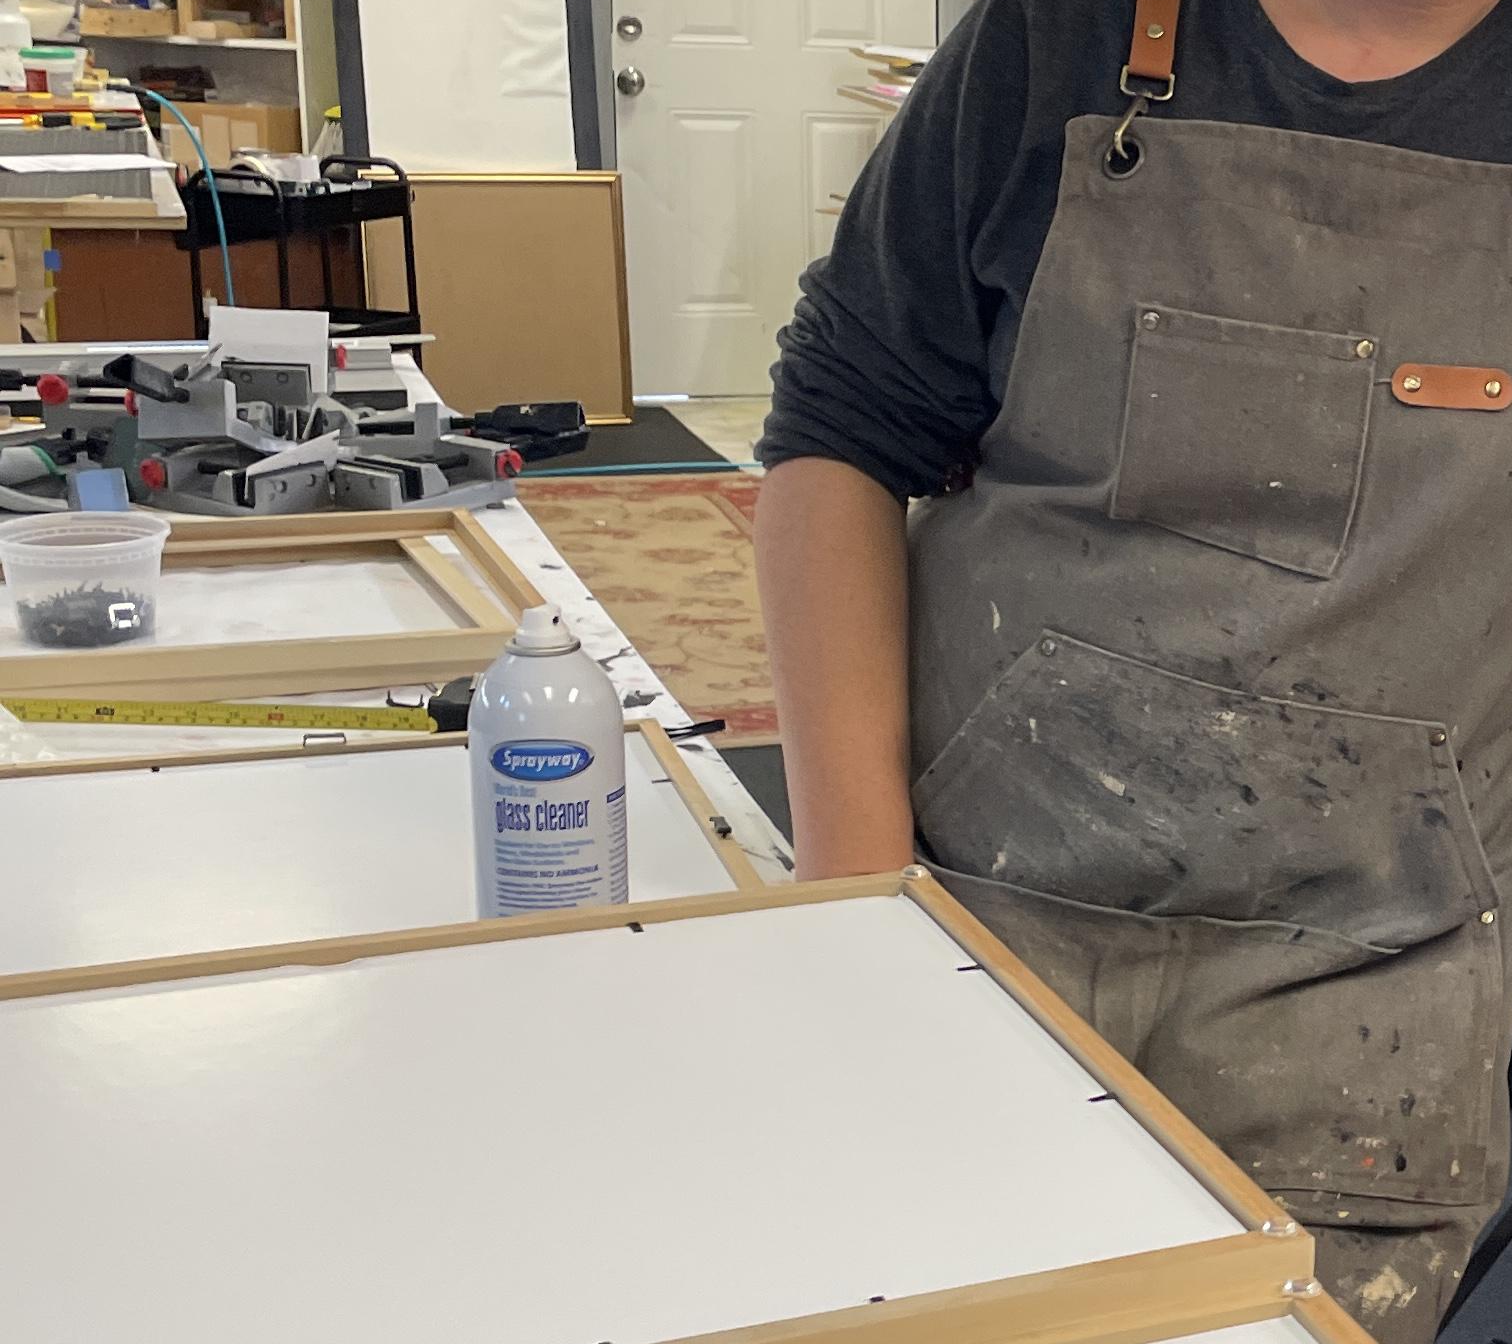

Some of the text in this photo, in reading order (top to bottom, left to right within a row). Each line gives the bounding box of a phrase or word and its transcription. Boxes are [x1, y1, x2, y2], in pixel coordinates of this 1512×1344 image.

[502, 750, 581, 772] Sprayway
[496, 798, 590, 833] glass cleaner
